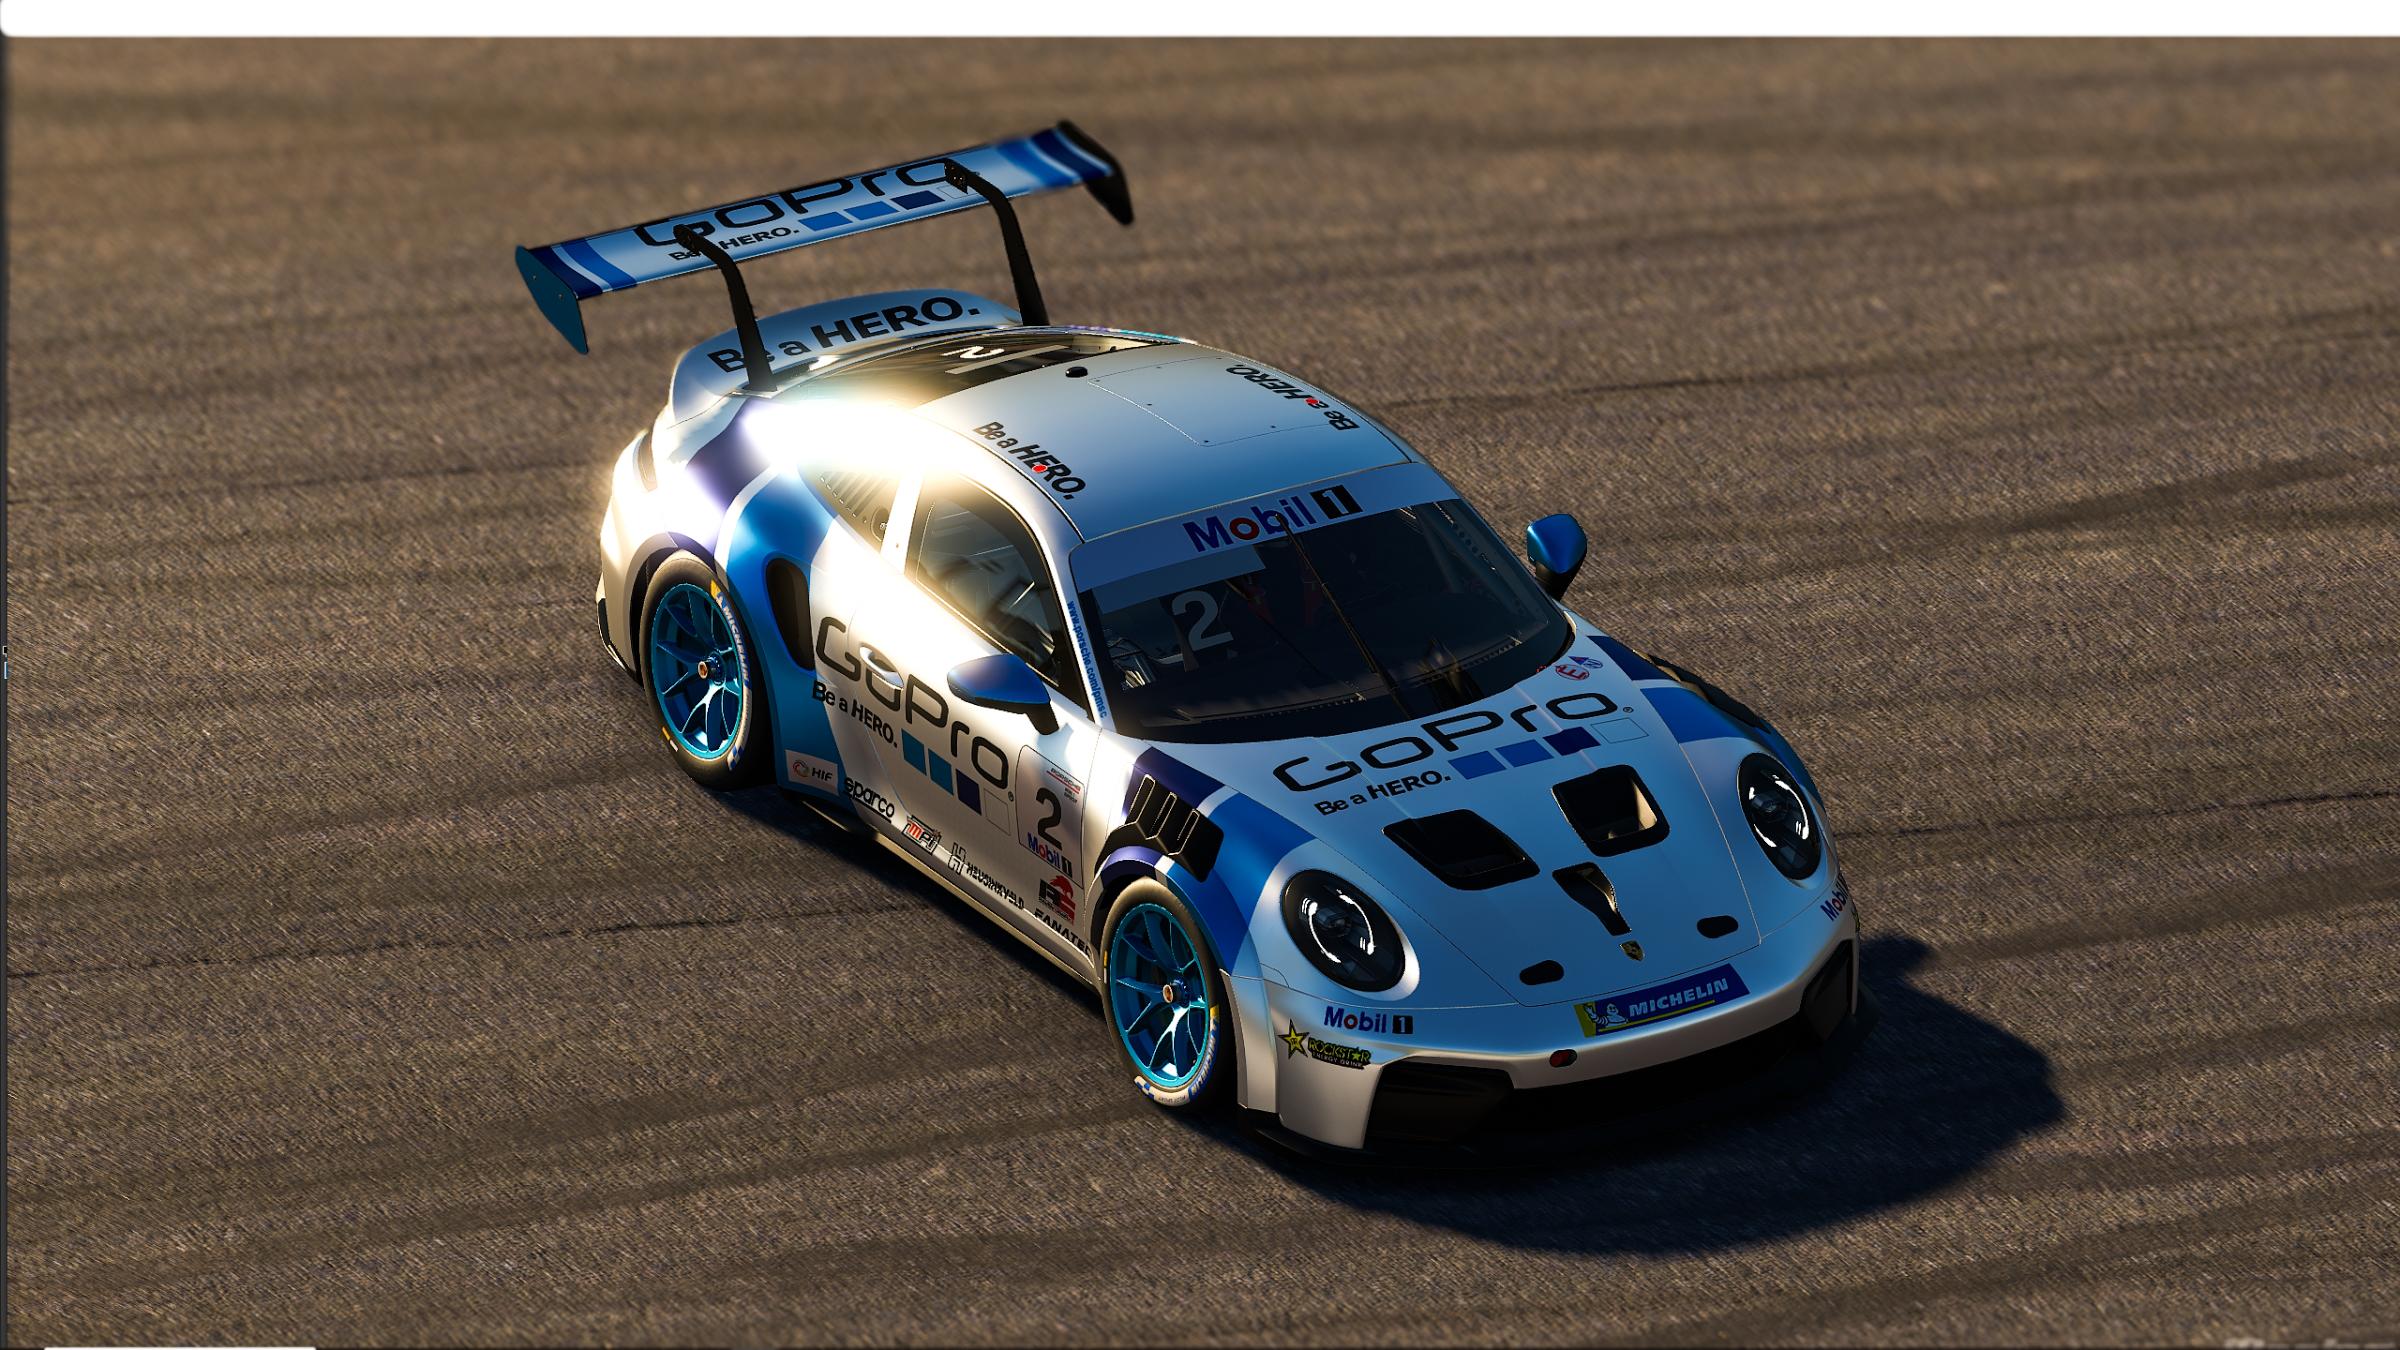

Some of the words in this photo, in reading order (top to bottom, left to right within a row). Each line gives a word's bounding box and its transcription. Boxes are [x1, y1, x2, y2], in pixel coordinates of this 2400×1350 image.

[633, 158, 950, 246] GoPro
[718, 226, 800, 250] HERO.
[779, 340, 811, 356] a
[811, 297, 980, 348] HERO.
[1226, 365, 1314, 400] HERO.
[1324, 410, 1360, 430] Be
[973, 422, 1006, 440] Be
[997, 438, 1018, 448] a
[1008, 444, 1086, 500] HERO.
[1182, 496, 1317, 552] Mobil
[1318, 487, 1355, 517] 1
[723, 606, 749, 682] MICHELIN
[1171, 590, 1234, 651] 2
[812, 680, 836, 706] Be
[839, 698, 848, 713] a
[851, 699, 898, 748] HERO.
[1273, 692, 1618, 792] GoPro
[812, 767, 833, 782] HIF
[844, 777, 895, 818] sparco
[1314, 799, 1348, 816] Be
[1350, 792, 1367, 805] a
[1367, 770, 1450, 801] HERO.
[1036, 787, 1062, 851] 2
[1028, 832, 1060, 868] Mobil
[1324, 1006, 1387, 1034] Mobil
[1629, 978, 1729, 1017] MICHELIN
